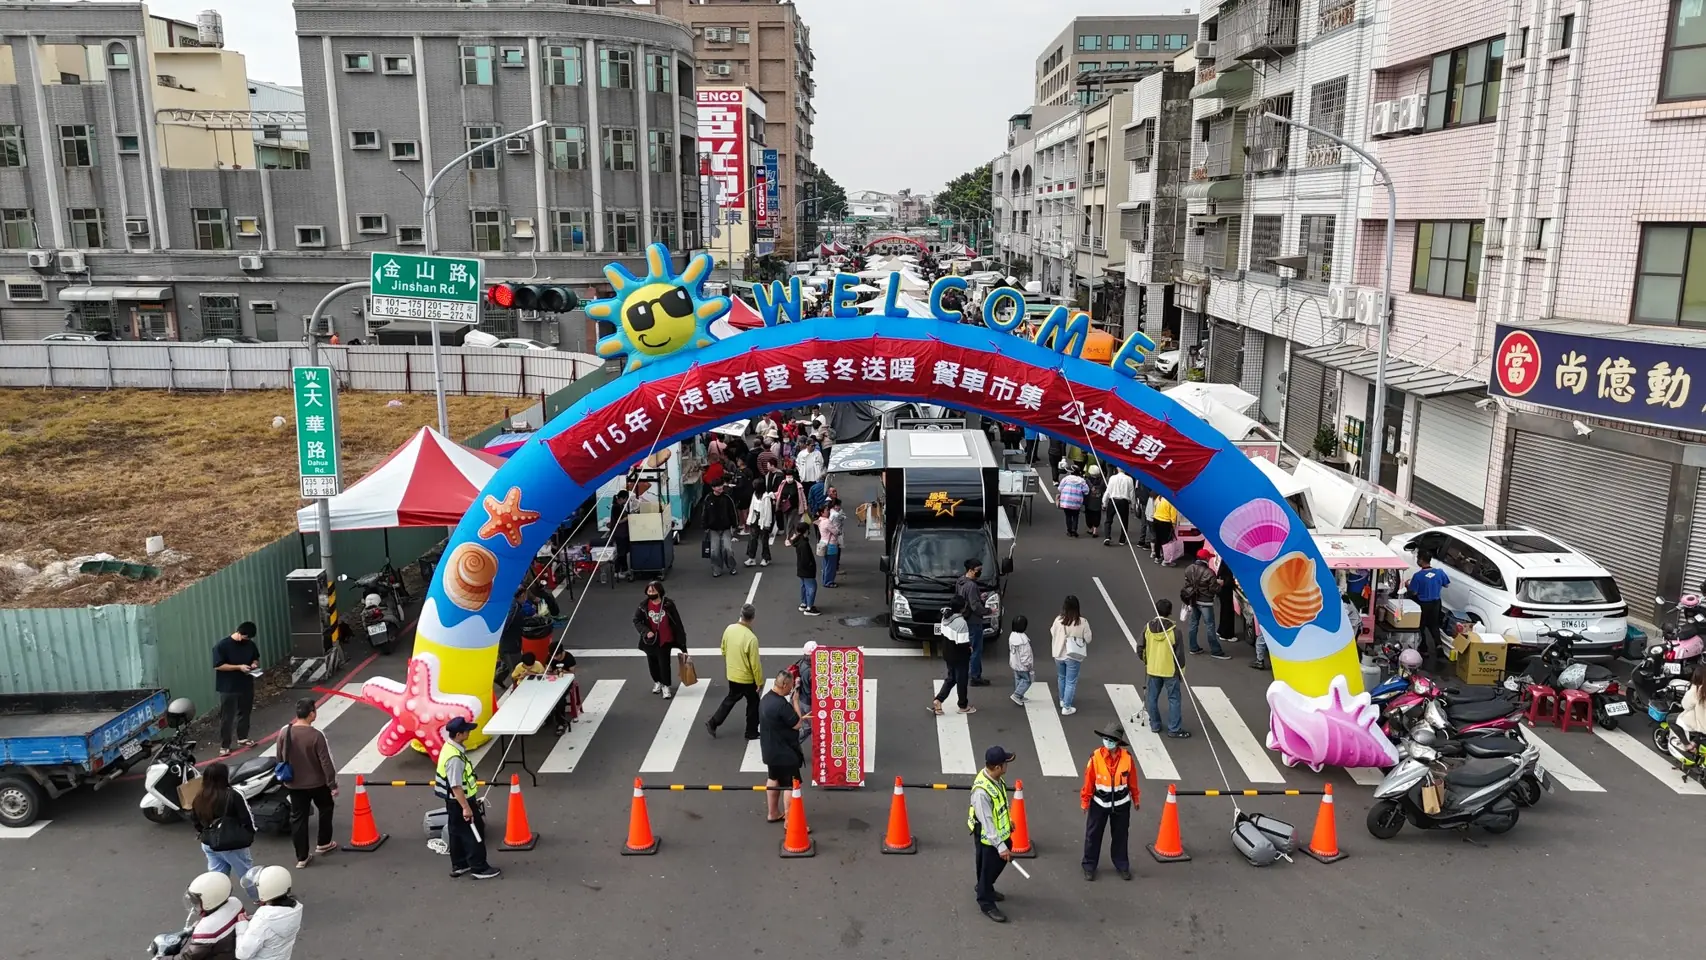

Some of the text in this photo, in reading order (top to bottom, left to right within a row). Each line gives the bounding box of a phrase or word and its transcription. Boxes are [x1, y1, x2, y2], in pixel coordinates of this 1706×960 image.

[697, 92, 740, 101] ENCO
[383, 258, 468, 283] 金山路
[391, 280, 459, 295] Jinshan Rd.
[385, 298, 422, 308] 101-175
[427, 301, 464, 311] 201-277
[385, 307, 422, 317] 102-150
[427, 310, 464, 320] 256-272
[752, 271, 1156, 378] WELCOME
[1504, 342, 1533, 385] 當
[304, 370, 320, 381] W.
[802, 356, 916, 384] 寒冬送暖
[932, 360, 1045, 411] 餐車市集
[1555, 350, 1706, 414] 尚億動
[303, 388, 327, 459] 大華路
[305, 478, 334, 486] 235 230
[306, 487, 334, 496] 193 188
